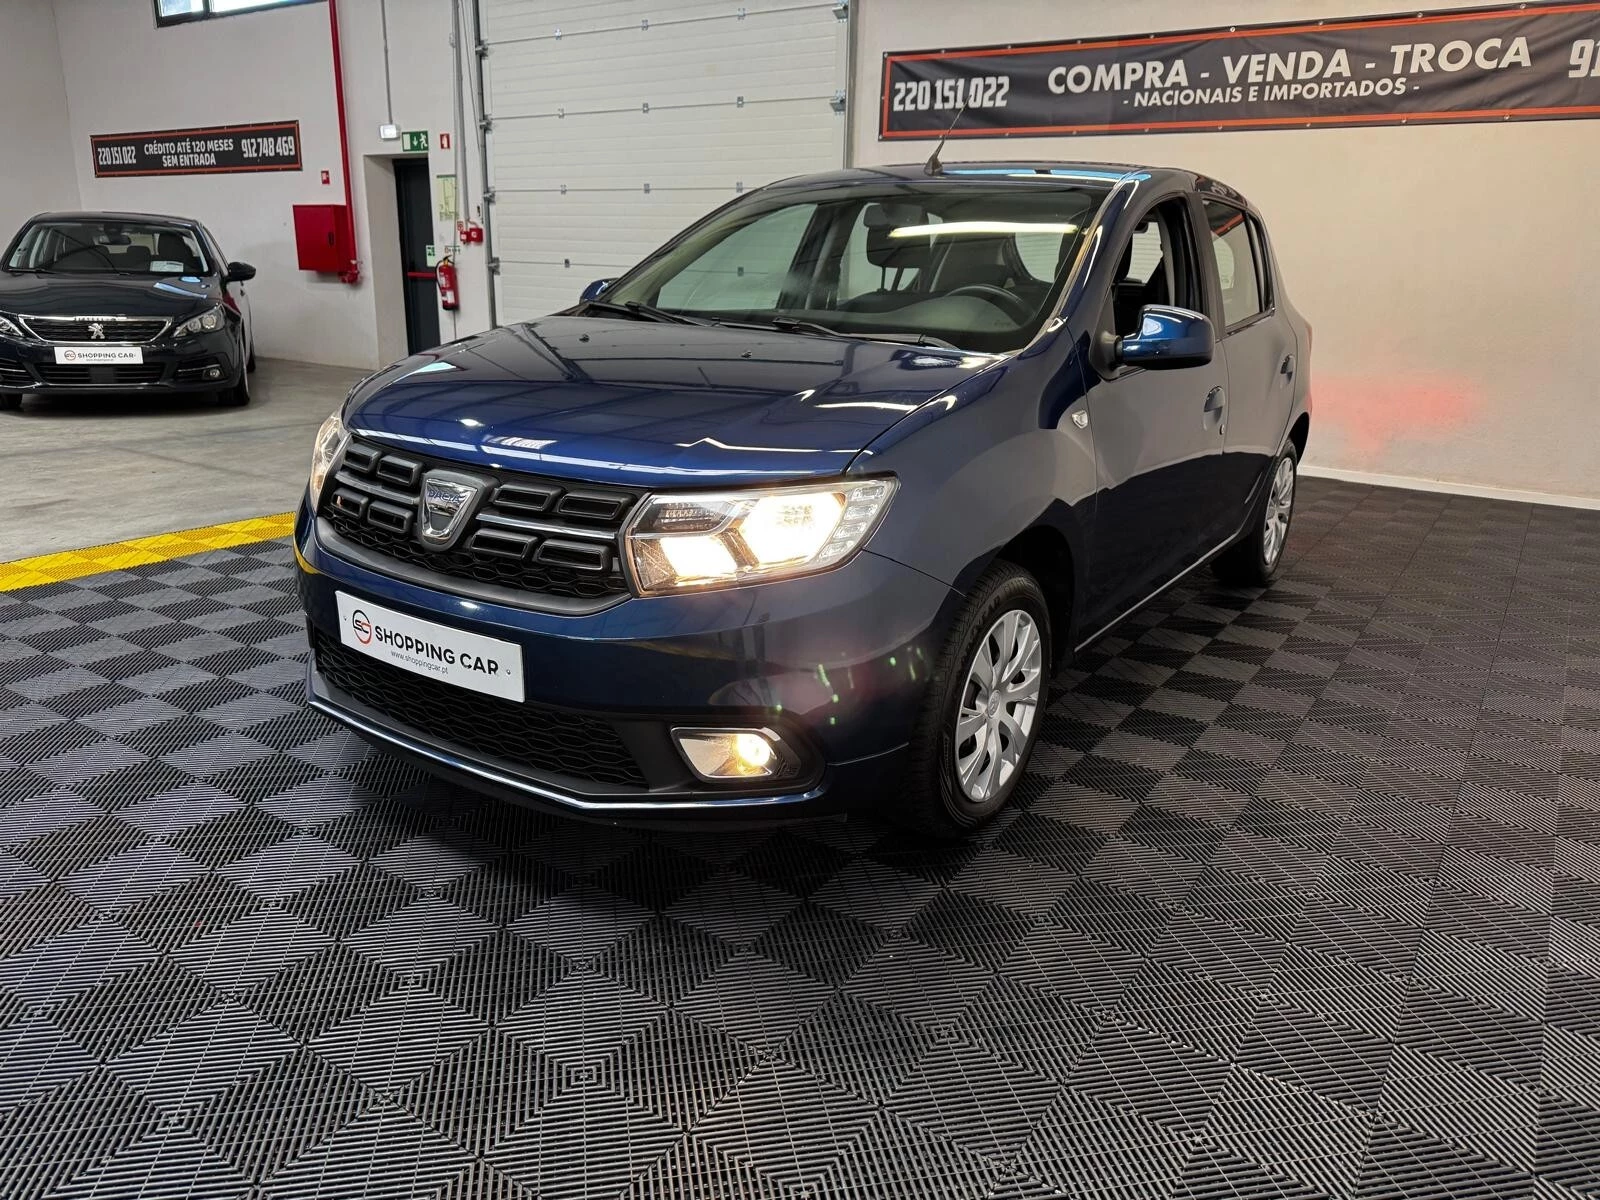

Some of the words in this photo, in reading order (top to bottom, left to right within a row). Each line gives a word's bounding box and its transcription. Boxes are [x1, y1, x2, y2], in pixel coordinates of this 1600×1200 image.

[1048, 59, 1190, 94] COMPRA
[1222, 48, 1351, 84] VENDA
[1390, 36, 1532, 75] TROCA
[893, 81, 931, 112] 220
[934, 78, 965, 110] 151
[967, 76, 1010, 109] 022
[1134, 87, 1243, 108] NACIONAIS
[1248, 86, 1258, 102] E
[1263, 77, 1407, 102] IMPORTADOS
[98, 147, 111, 165] 220
[122, 146, 137, 164] 022
[144, 140, 176, 155] CRÉDITO
[177, 138, 191, 153] ATÉ
[192, 140, 206, 153] 120
[207, 139, 234, 152] MESES
[241, 138, 257, 158] 912
[257, 137, 275, 157] 748
[276, 136, 296, 156] 469
[162, 154, 179, 167] SEM
[179, 153, 216, 166] ENTRADA
[375, 625, 456, 665] SHOPPING
[459, 652, 499, 675] CAR
